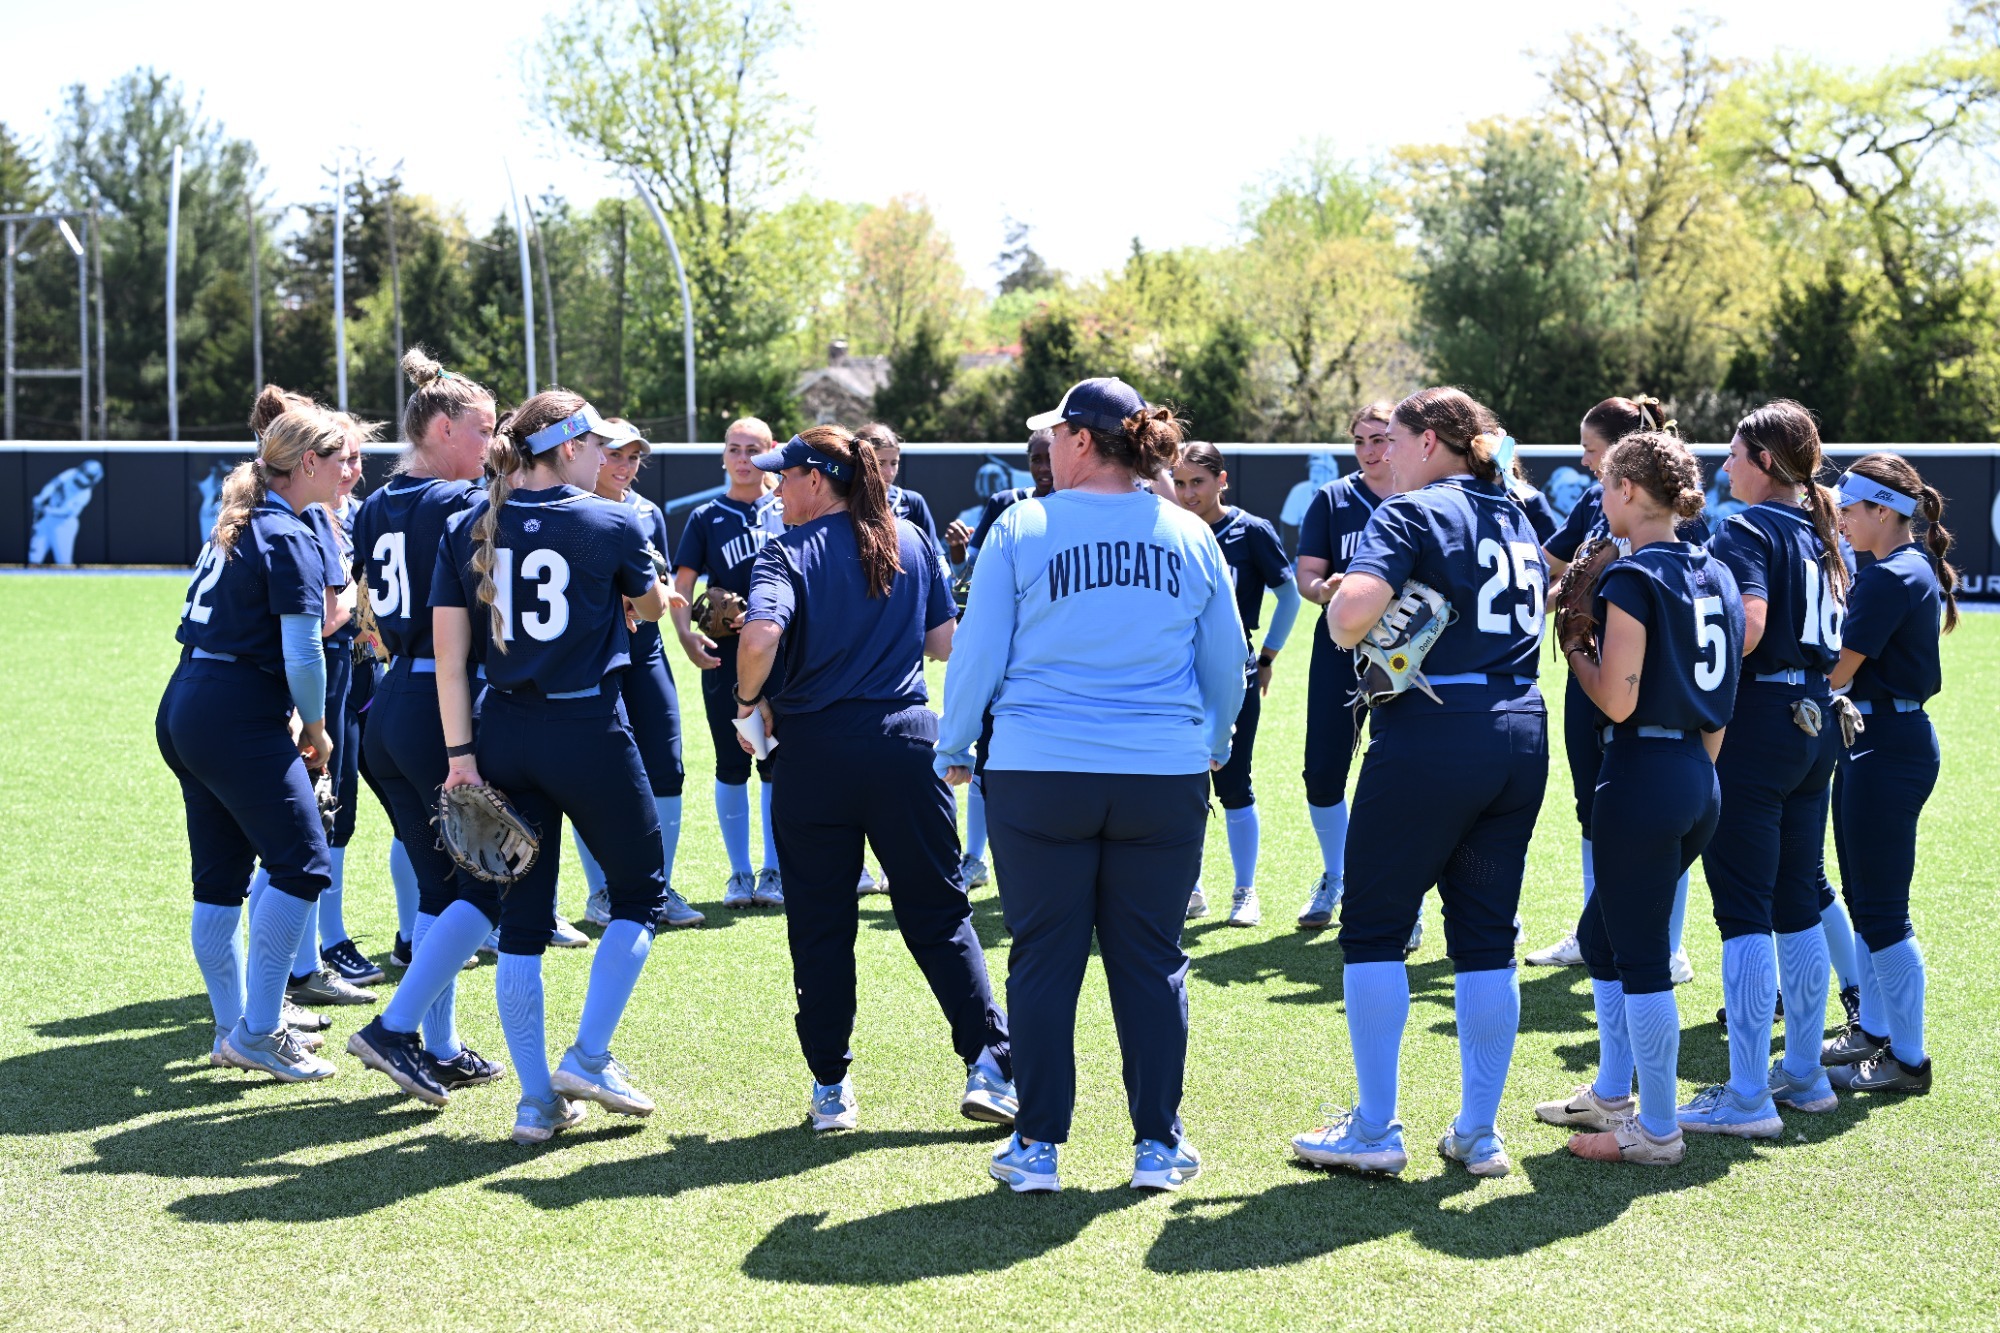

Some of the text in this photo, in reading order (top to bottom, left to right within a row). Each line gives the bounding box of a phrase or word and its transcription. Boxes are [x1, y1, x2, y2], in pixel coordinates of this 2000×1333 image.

[368, 532, 411, 619] 31
[491, 547, 570, 642] 13
[1048, 540, 1181, 603] WILDCATS
[1477, 538, 1546, 636] 25
[1694, 595, 1727, 692] 5
